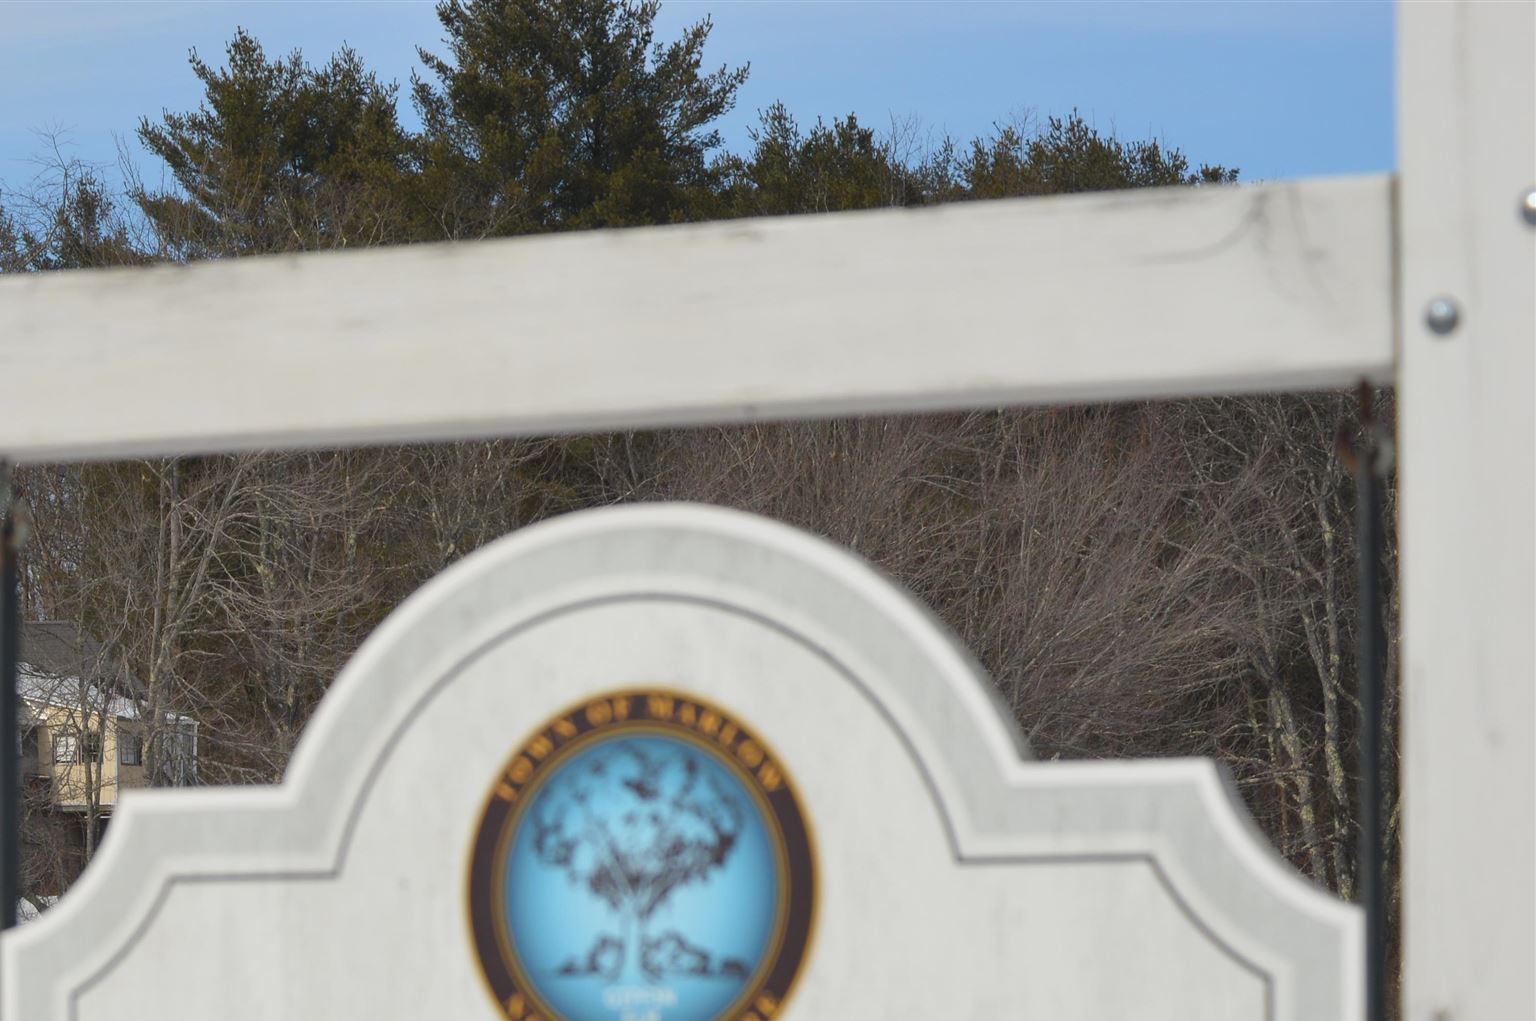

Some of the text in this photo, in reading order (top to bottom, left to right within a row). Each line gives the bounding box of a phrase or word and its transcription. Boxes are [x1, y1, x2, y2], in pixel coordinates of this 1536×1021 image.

[494, 694, 784, 803] TOWN OF MARLOW
